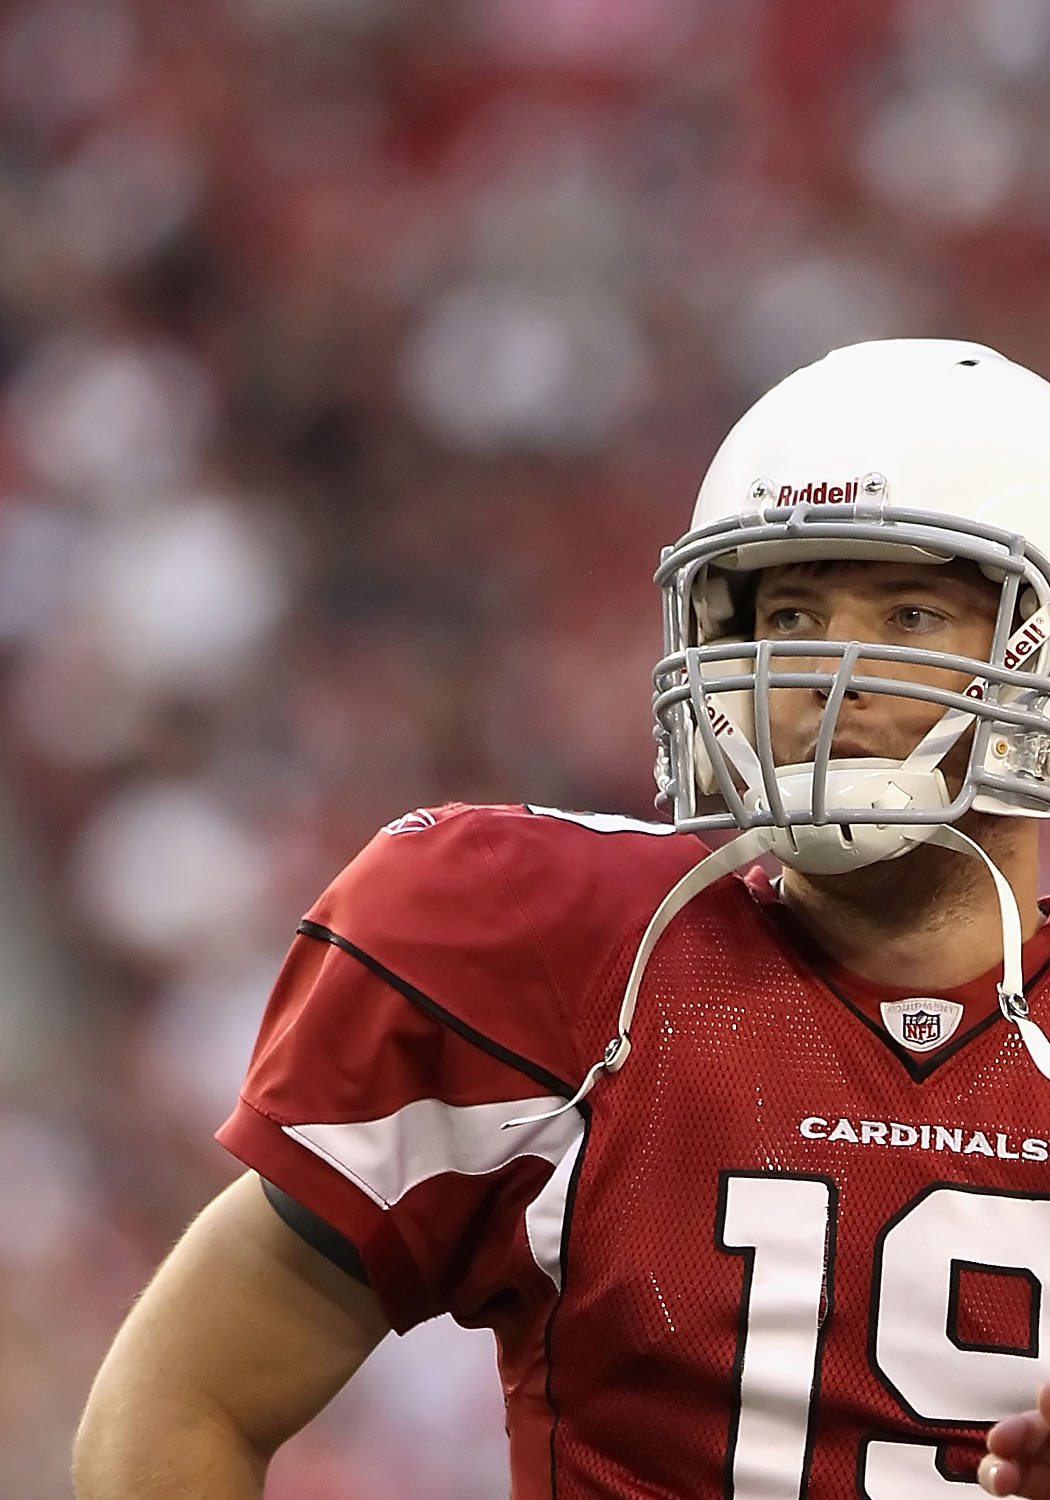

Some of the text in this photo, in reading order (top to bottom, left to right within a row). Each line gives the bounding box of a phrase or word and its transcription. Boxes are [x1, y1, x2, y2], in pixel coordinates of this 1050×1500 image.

[776, 482, 859, 507] Riddell
[906, 1023, 937, 1041] NFL
[799, 1115, 1050, 1163] CARDINALS
